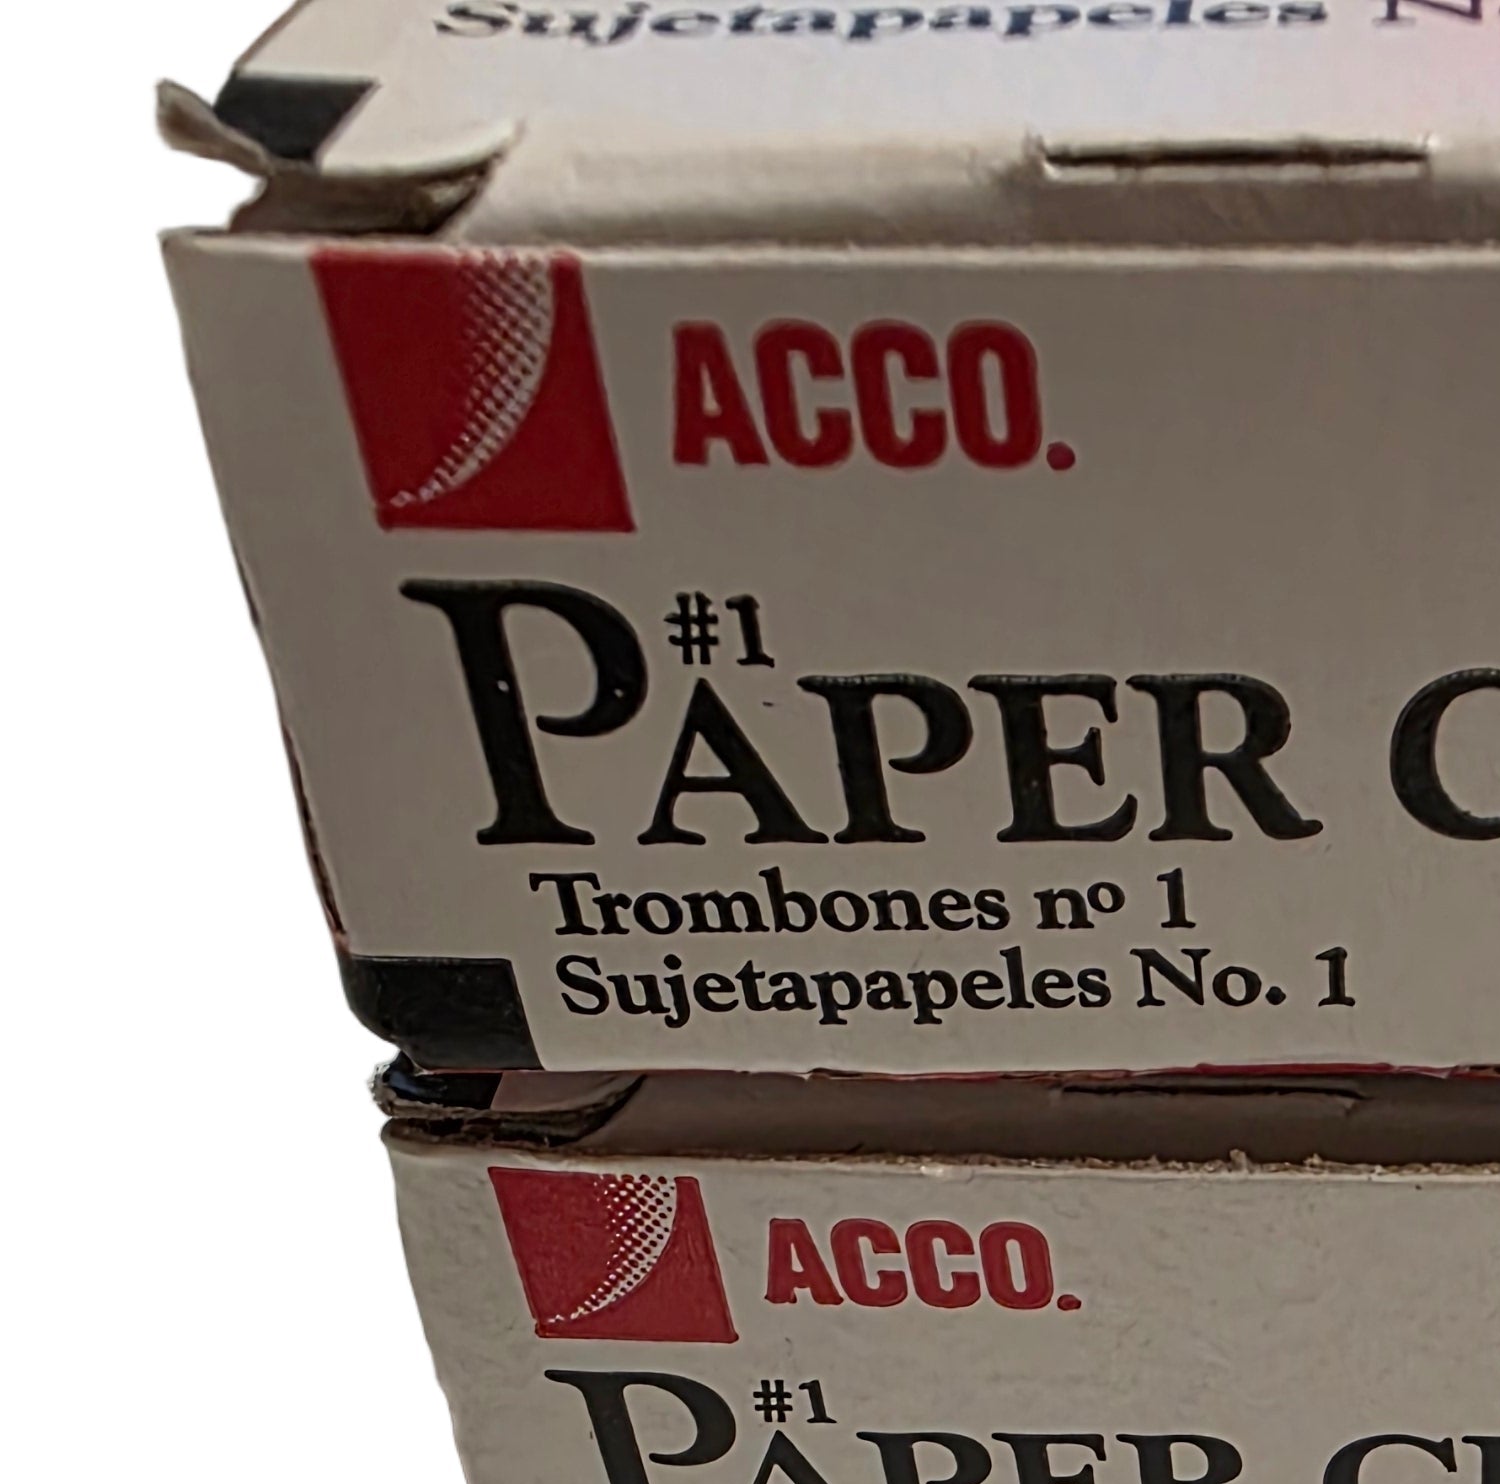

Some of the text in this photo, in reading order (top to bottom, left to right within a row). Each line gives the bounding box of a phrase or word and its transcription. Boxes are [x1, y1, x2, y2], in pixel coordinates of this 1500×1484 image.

[662, 590, 776, 668] #1
[400, 578, 1324, 846] PAPER
[528, 866, 1010, 938] Trombones
[1156, 868, 1198, 931] 1
[555, 946, 1357, 1030] Sujetapapeles No. 1
[752, 1378, 838, 1425] #1
